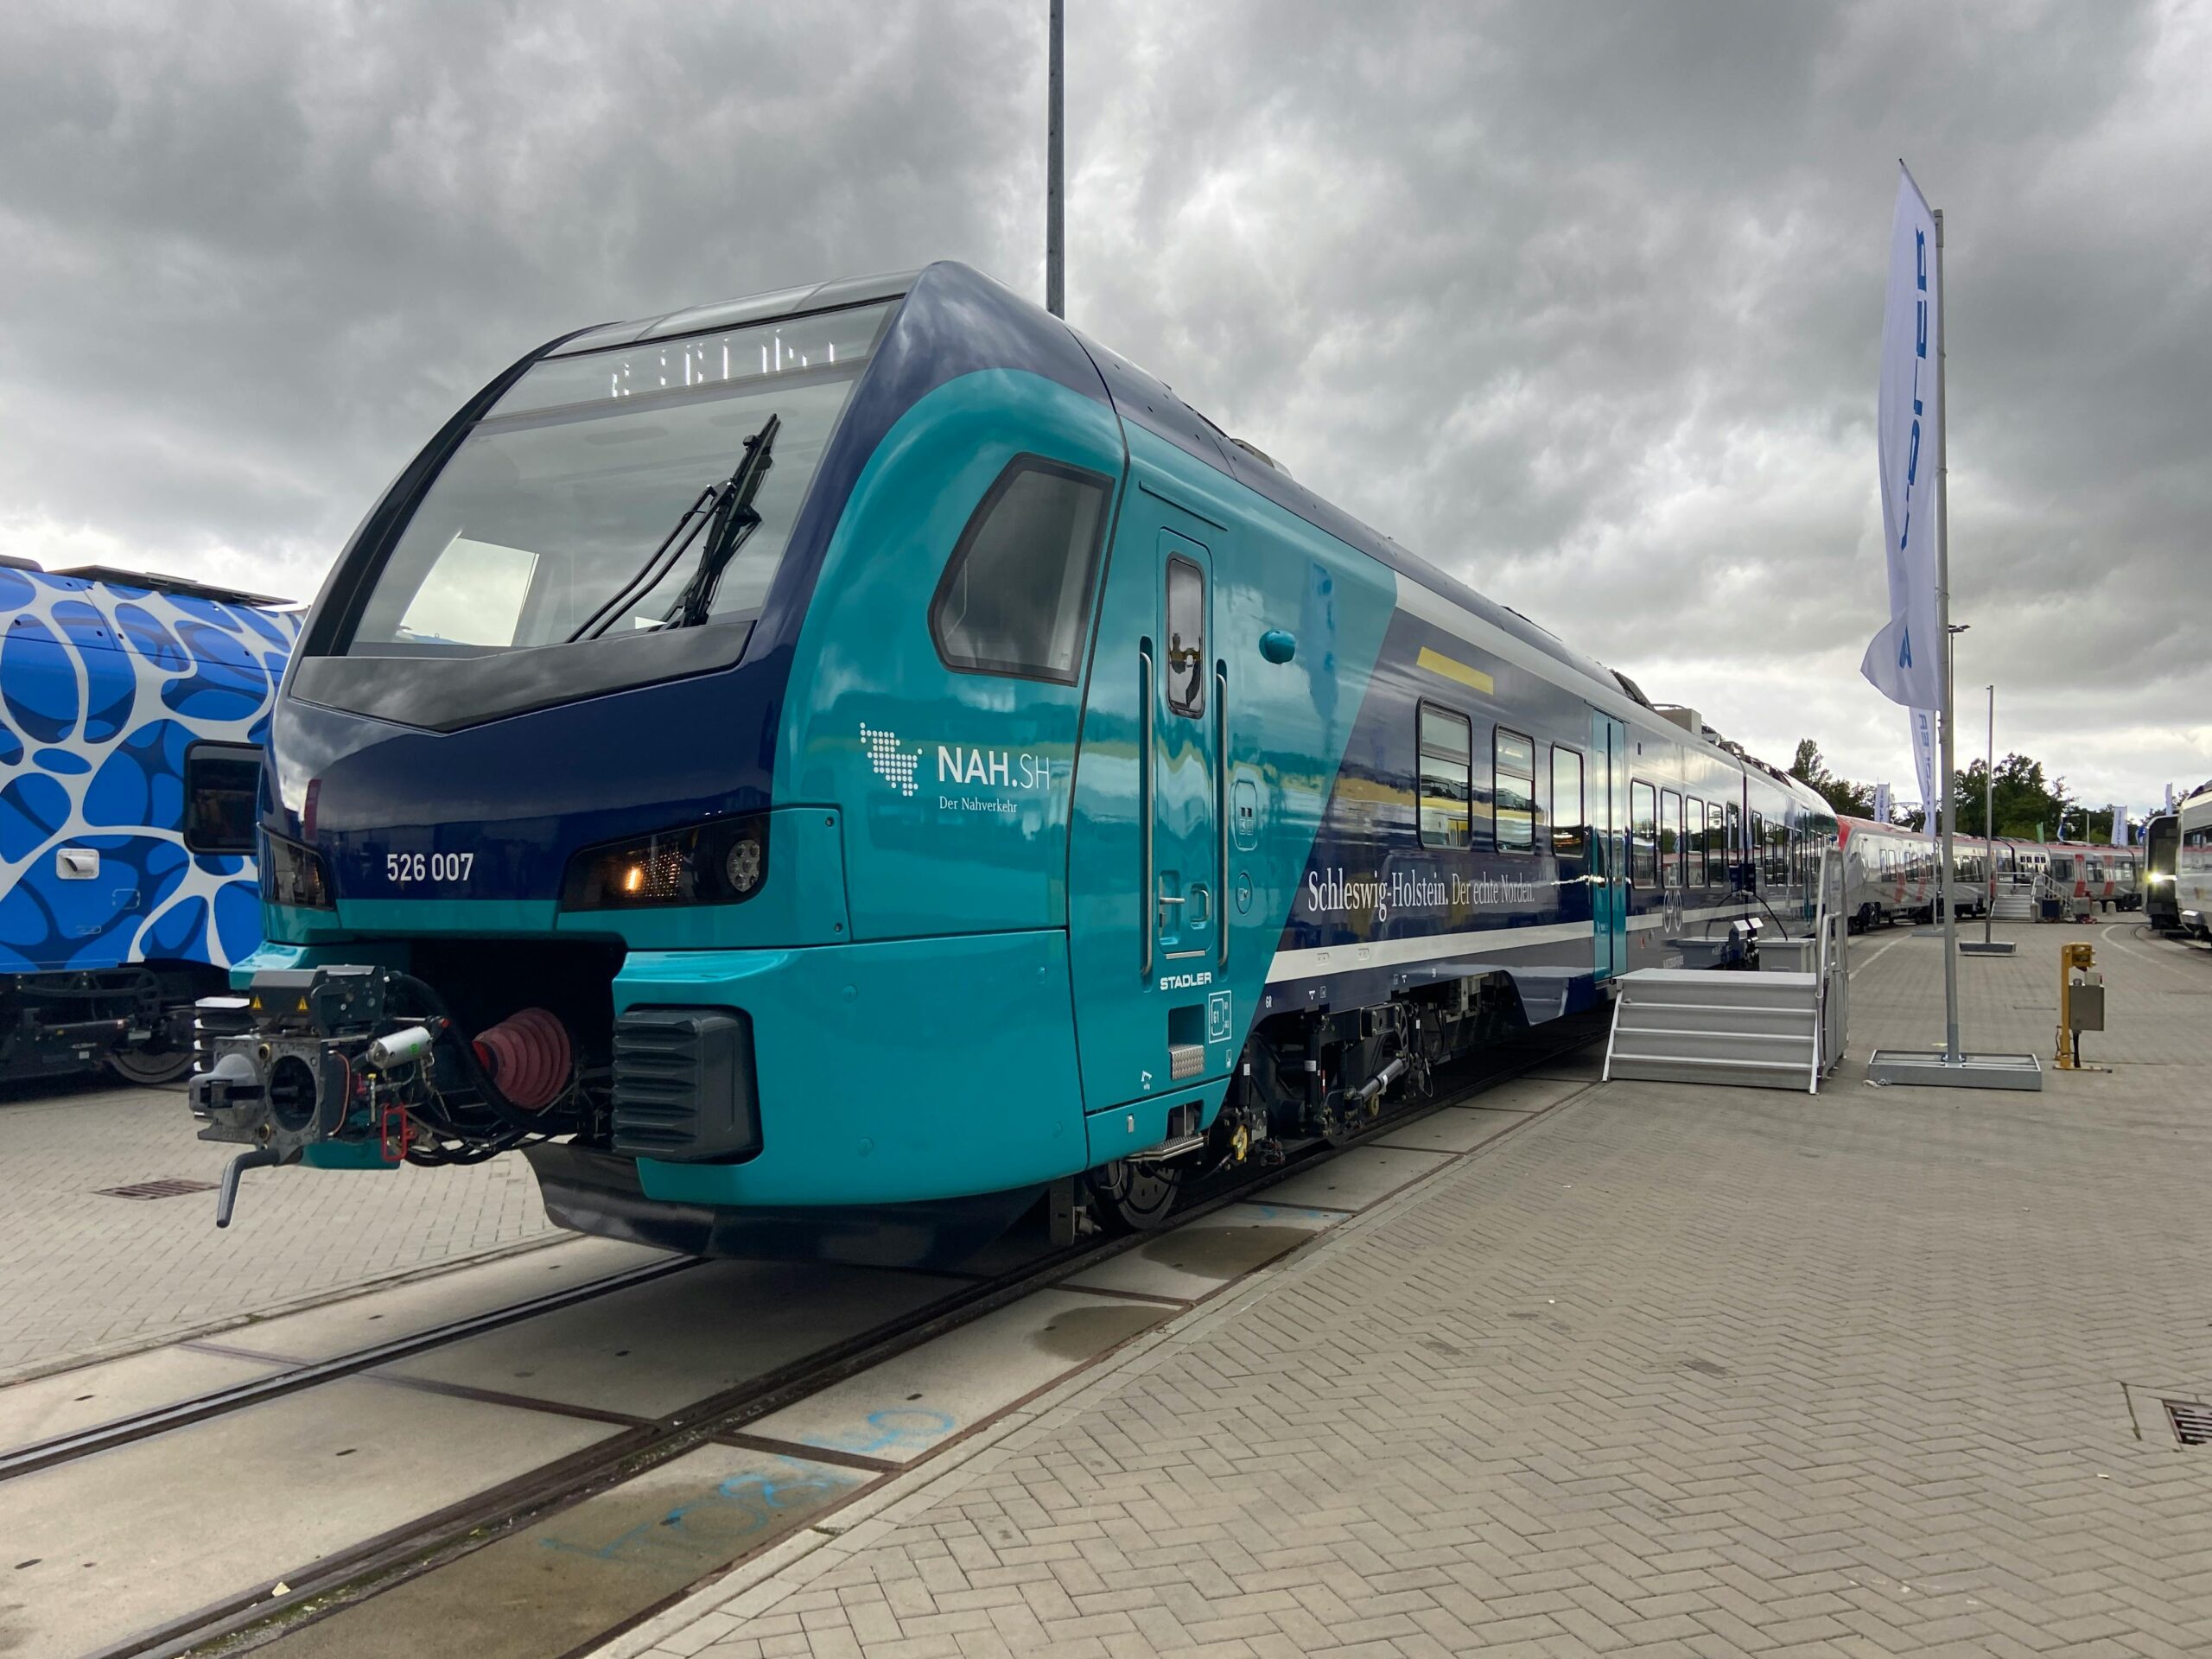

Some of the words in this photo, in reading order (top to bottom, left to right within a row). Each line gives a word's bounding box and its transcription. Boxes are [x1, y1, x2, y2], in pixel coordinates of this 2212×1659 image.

[938, 746, 1050, 790] NAH.SH
[939, 795, 957, 810] Der
[962, 797, 1018, 813] Nahverkehr
[387, 853, 426, 881] 526
[432, 853, 474, 880] 007
[1308, 867, 1449, 922] Schleswig-Holstein.
[1452, 873, 1471, 905] Der
[1473, 872, 1498, 904] echte
[1501, 873, 1535, 904] Norden.
[1160, 971, 1211, 990] STADLER
